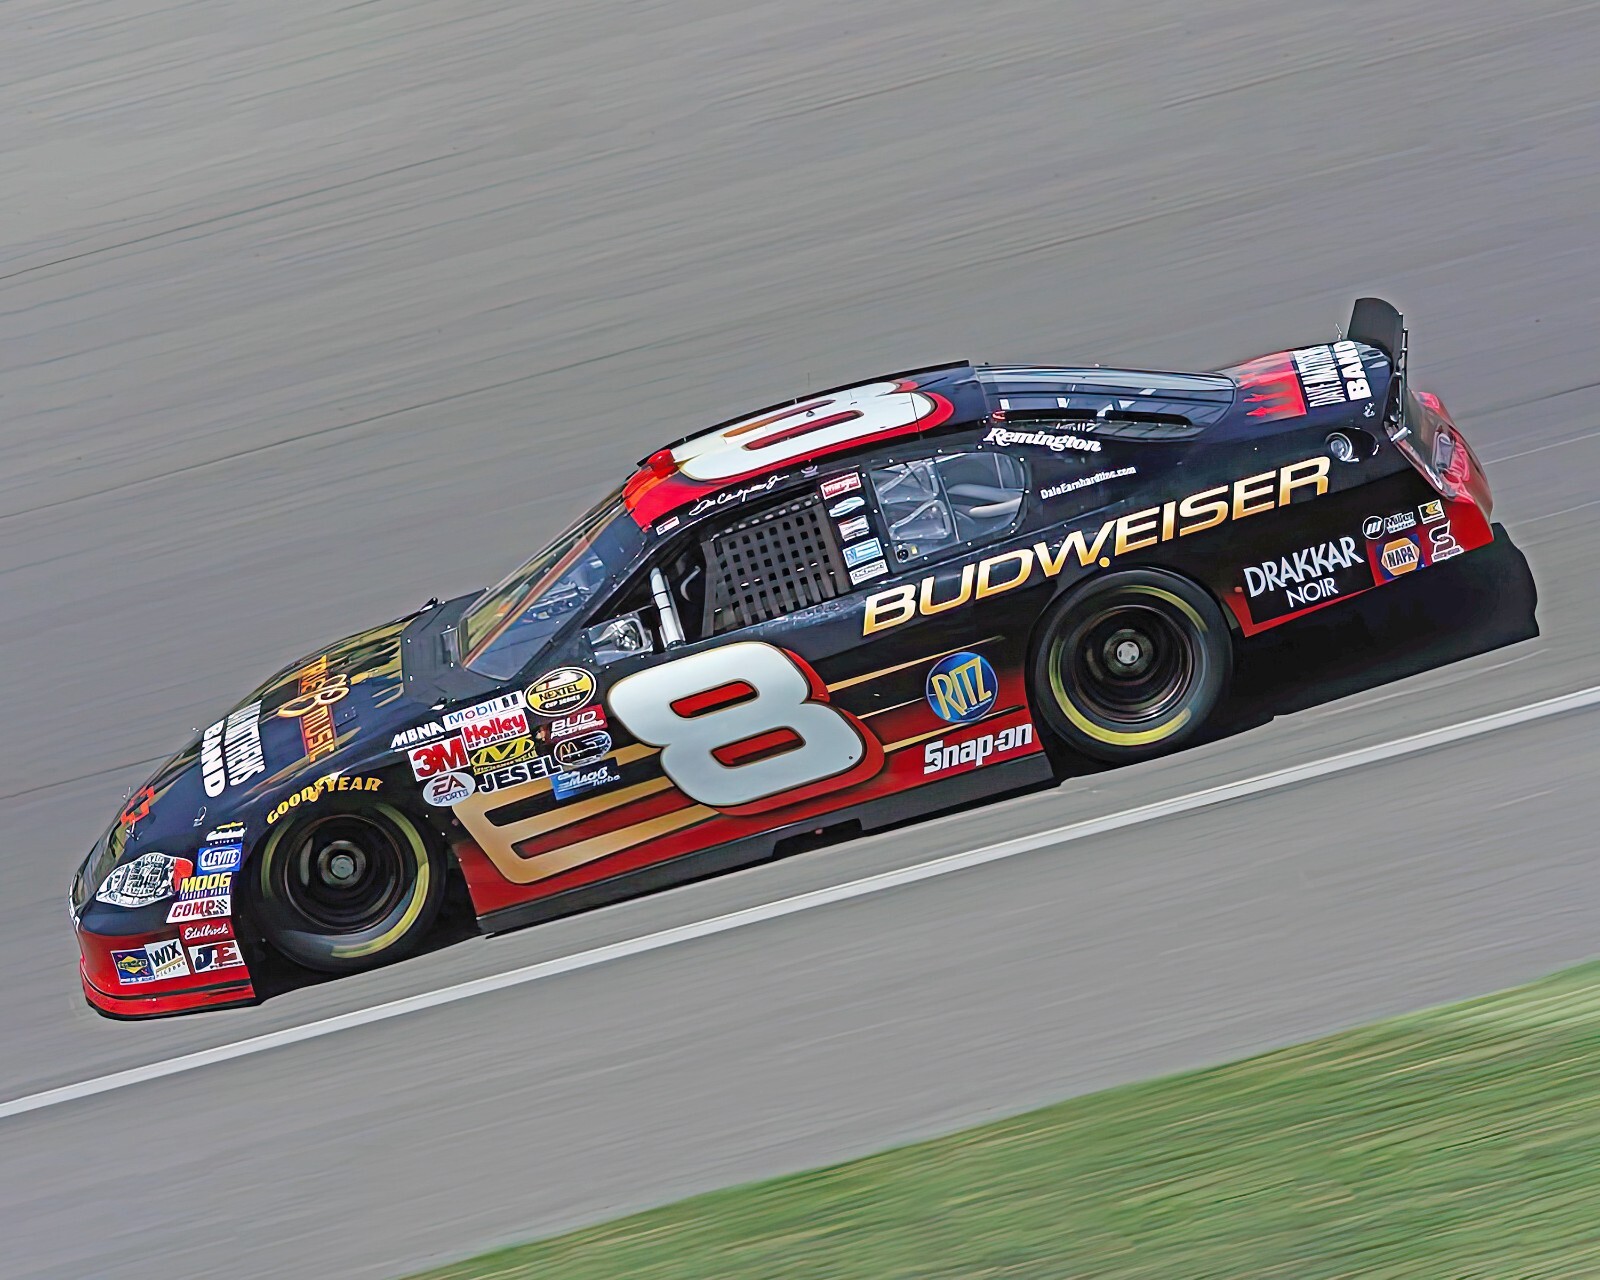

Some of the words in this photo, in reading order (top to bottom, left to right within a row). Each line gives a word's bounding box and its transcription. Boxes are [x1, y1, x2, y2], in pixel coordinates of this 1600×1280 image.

[1333, 340, 1373, 401] BAND
[983, 427, 1102, 452] Remington
[862, 456, 1332, 637] BUDWEISER
[1386, 545, 1416, 568] NAPA
[1243, 536, 1364, 598] DRAKKAR
[1286, 577, 1339, 608] NOIR
[540, 683, 581, 702] NEXTEL
[931, 655, 992, 720] RITZ
[448, 700, 498, 725] Mobil
[551, 710, 597, 732] BUD
[606, 641, 866, 807] 8
[302, 705, 335, 763] MUSIC
[390, 721, 447, 750] MBNA
[463, 713, 527, 744] Holley
[201, 719, 226, 798] BAND
[412, 737, 469, 778] 3M
[923, 723, 1033, 775] Snap-on
[432, 775, 466, 797] EA
[480, 757, 562, 792] JESEL
[266, 776, 383, 825] GOODYEAR
[201, 848, 240, 868] CLEVITE
[180, 872, 232, 894] MOOG
[172, 899, 216, 918] COMP
[184, 923, 229, 940] Edelbrock
[149, 941, 182, 968] WIX
[194, 942, 238, 971] JE
